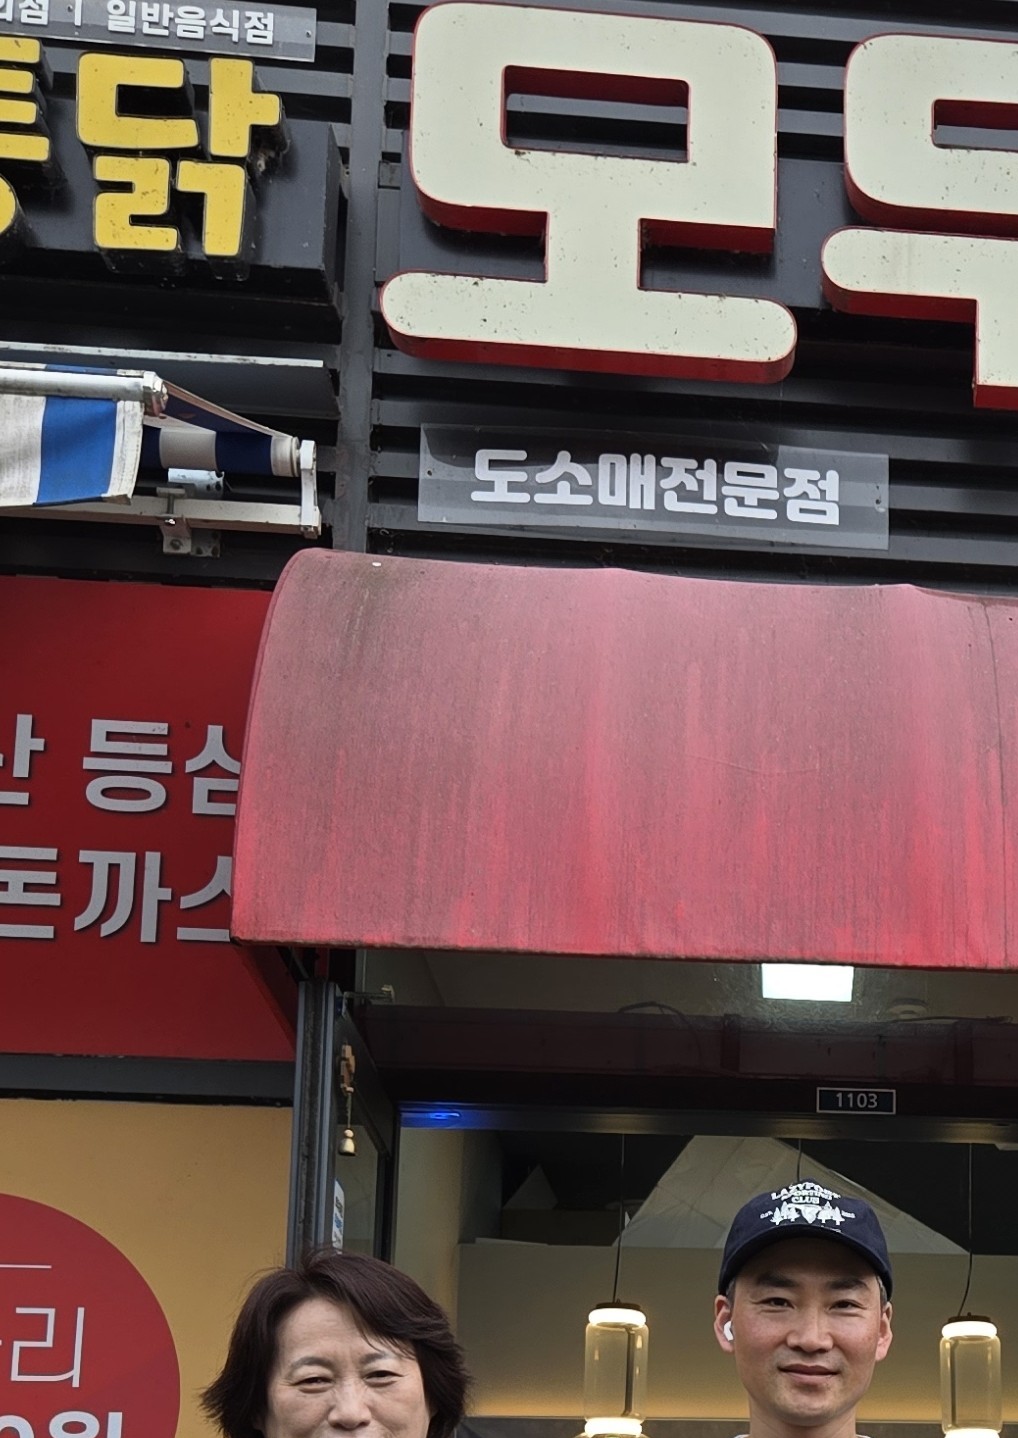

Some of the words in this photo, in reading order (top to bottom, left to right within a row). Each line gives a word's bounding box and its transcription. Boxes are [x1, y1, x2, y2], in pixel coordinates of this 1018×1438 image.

[106, 0, 275, 45] 일반음식점
[471, 449, 840, 526] 도소매전문점
[836, 1092, 878, 1109] 1103
